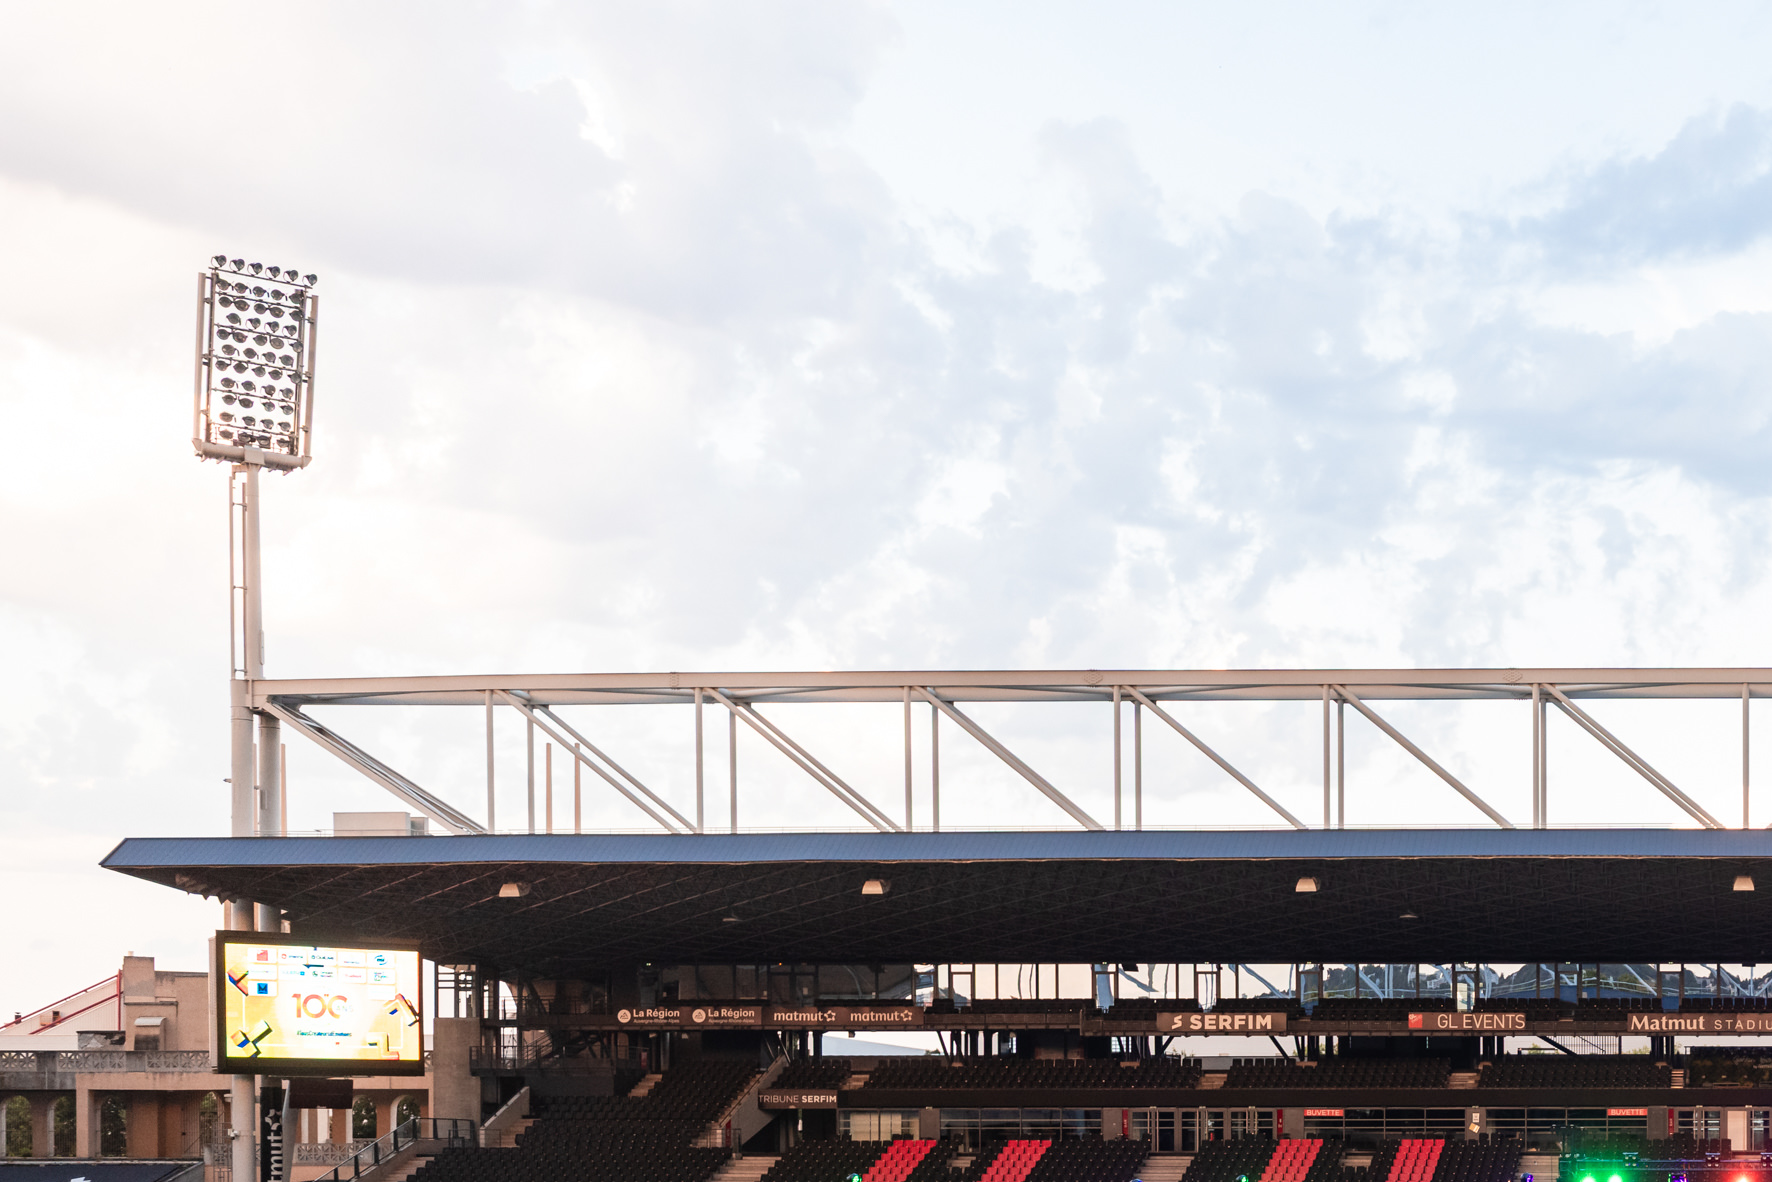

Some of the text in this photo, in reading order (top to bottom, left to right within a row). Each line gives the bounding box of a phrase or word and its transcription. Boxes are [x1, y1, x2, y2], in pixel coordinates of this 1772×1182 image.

[633, 1008, 680, 1019] La Région
[708, 1008, 755, 1019] La Région
[773, 1011, 823, 1021] matmut
[850, 1011, 900, 1021] matmut
[1190, 1014, 1272, 1030] SERFIM
[1437, 1014, 1526, 1029] GL EVENTS
[1631, 1015, 1705, 1031] Matmut
[759, 1095, 837, 1103] TRIBUNE SERFIM
